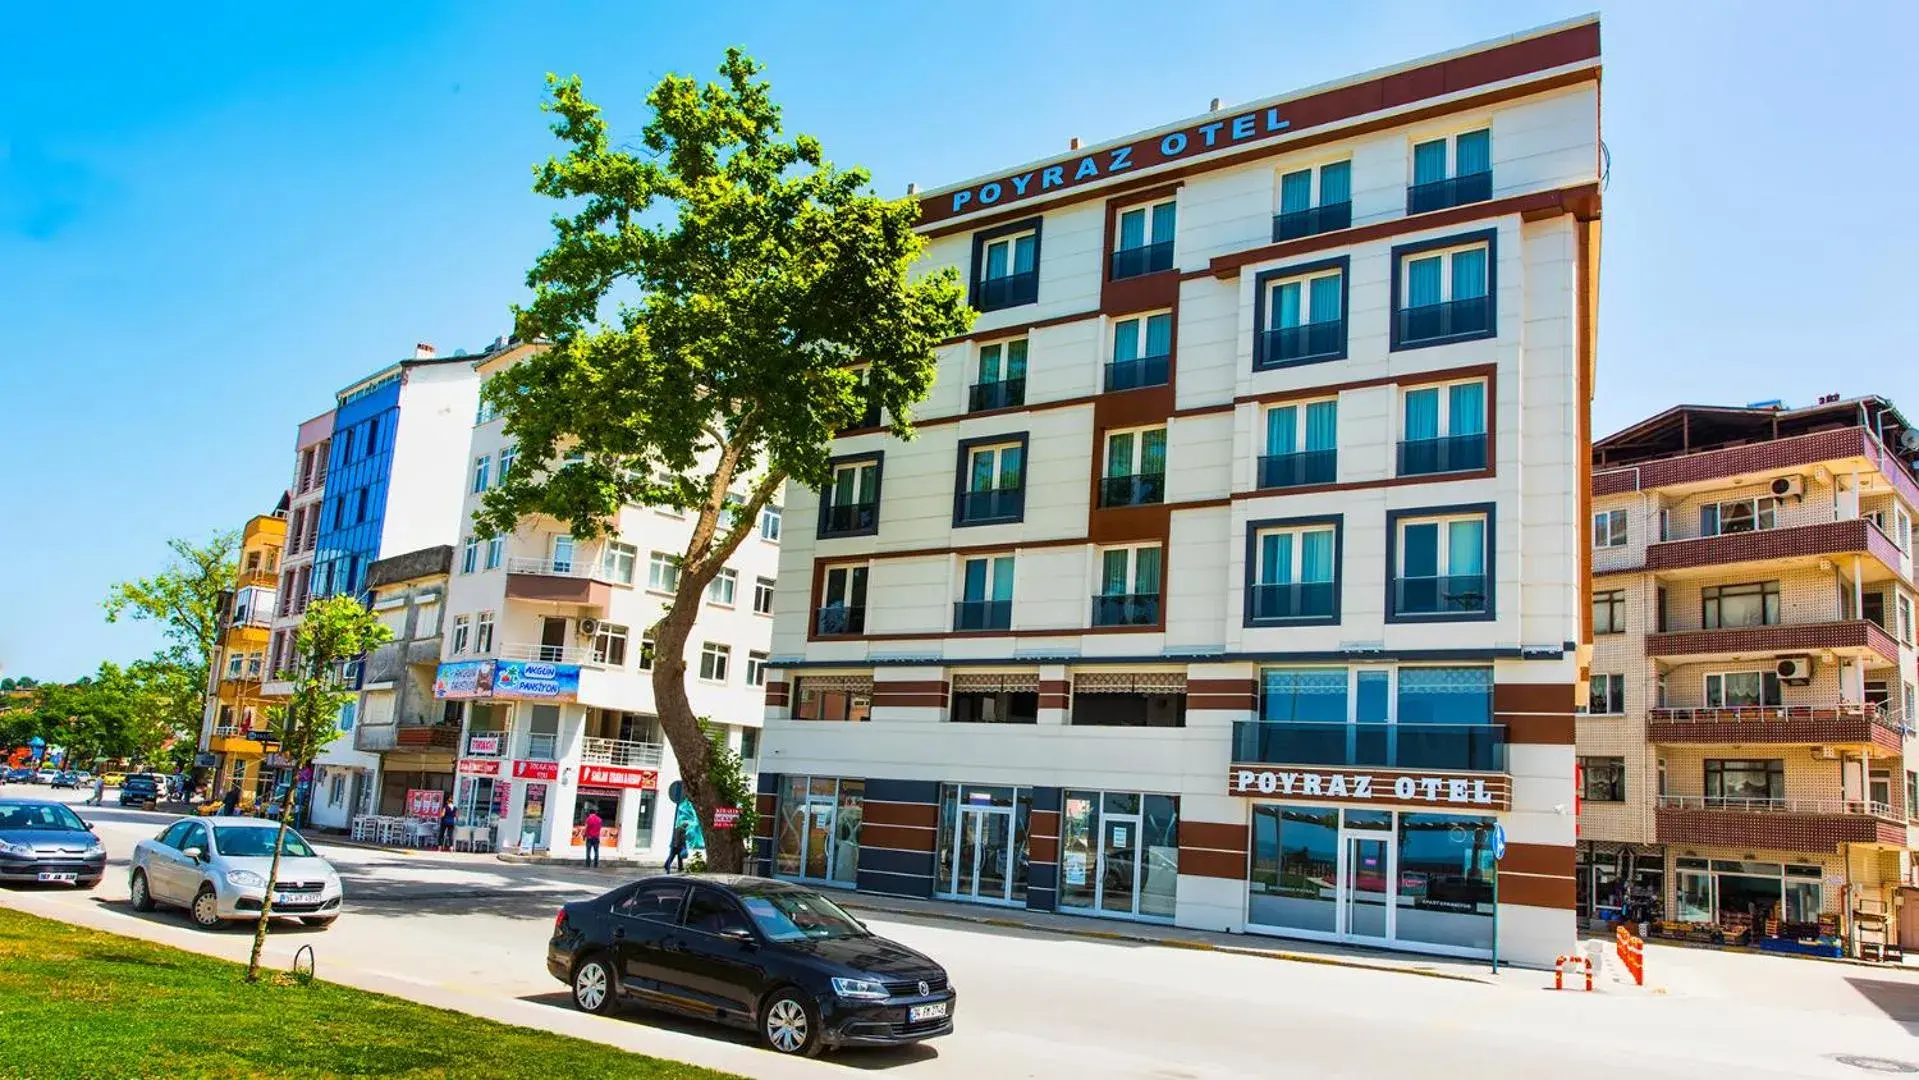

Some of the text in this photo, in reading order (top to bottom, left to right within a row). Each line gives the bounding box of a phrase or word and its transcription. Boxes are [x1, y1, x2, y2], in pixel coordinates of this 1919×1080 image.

[952, 108, 1291, 213] POYRAZ OTEL
[1237, 769, 1492, 804] POYRAZ OTEL
